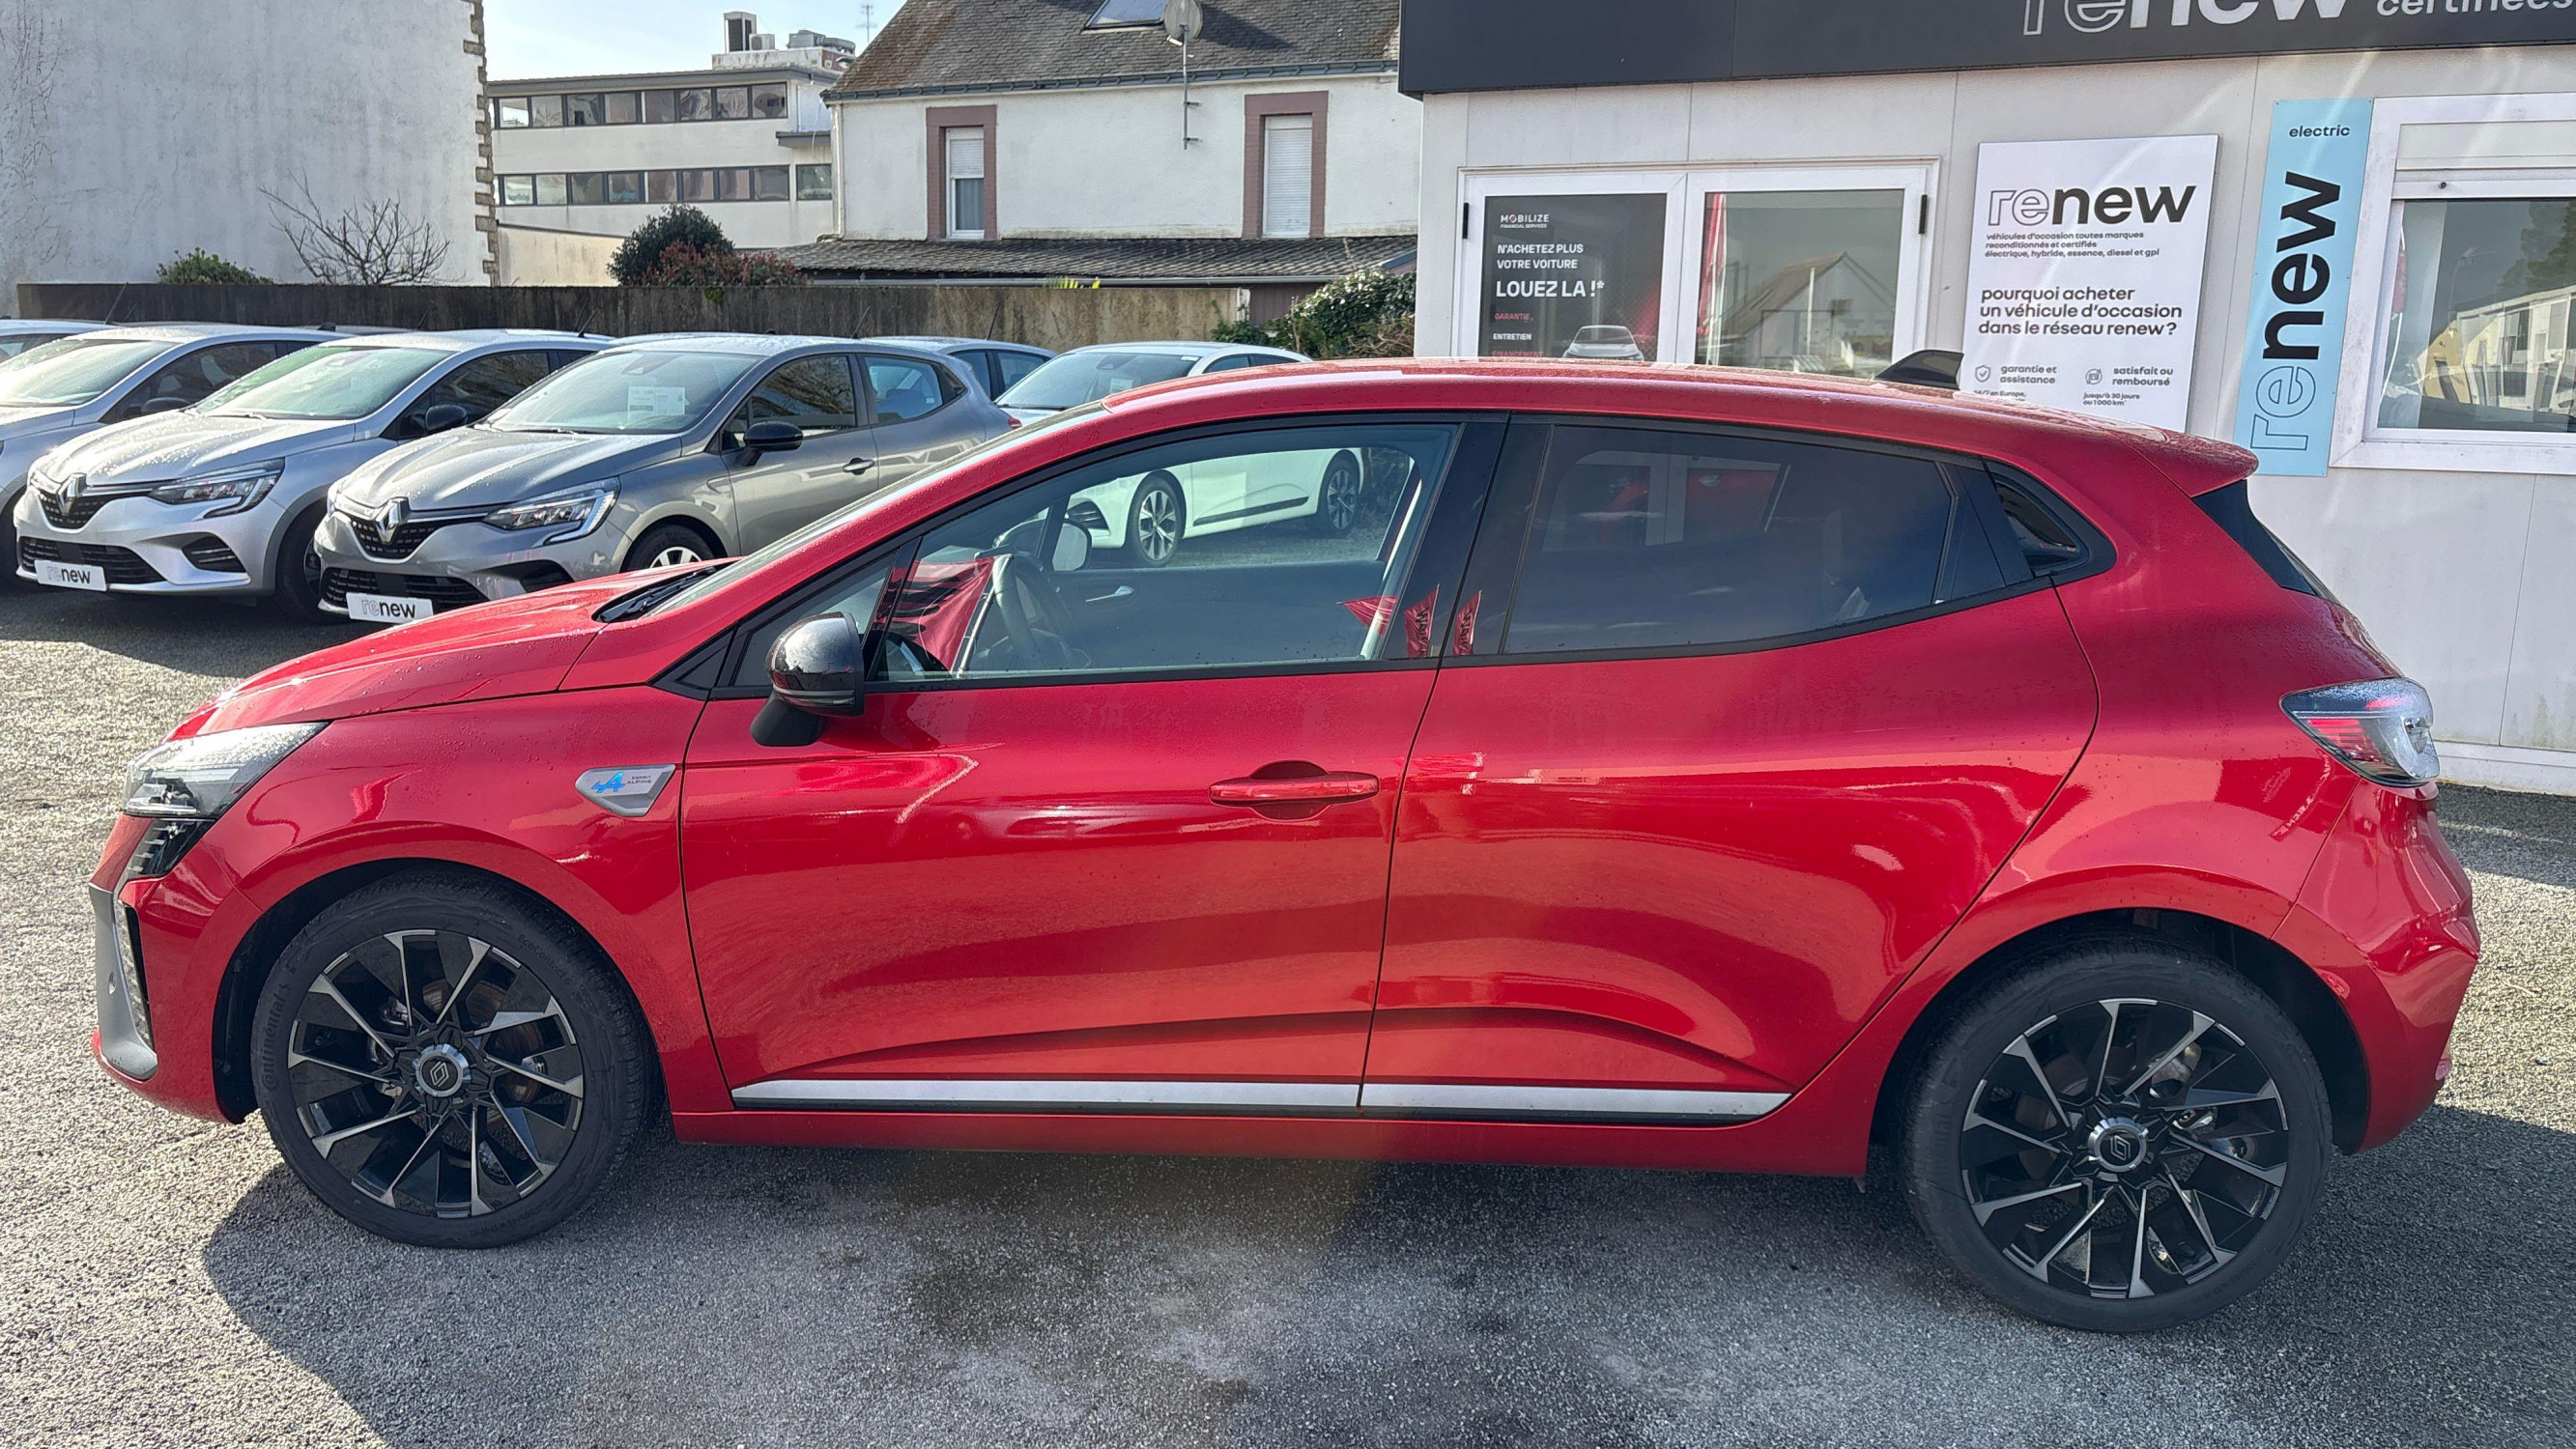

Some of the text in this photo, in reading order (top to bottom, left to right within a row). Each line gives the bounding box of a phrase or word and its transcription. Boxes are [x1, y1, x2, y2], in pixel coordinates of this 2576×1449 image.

[2289, 125, 2351, 137] electric
[1988, 185, 2196, 226] renew
[1501, 213, 1550, 223] MOBILIZE
[2027, 232, 2075, 241] d'occasion
[2104, 232, 2144, 241] marques
[1497, 243, 1584, 254] N'ACHETEZ PLUS
[1985, 249, 2030, 258] électrique,
[2030, 249, 2066, 258] hybride,
[2106, 248, 2132, 257] diesel
[2145, 248, 2160, 258] gpl
[1497, 259, 1578, 270] VOTRE VOITURE
[1496, 280, 1558, 298] LOUEZ
[1561, 280, 1587, 298] LA
[1981, 286, 2135, 303] pourquoi acheter
[1980, 303, 2183, 318] un véhicule d'occasion
[2250, 171, 2341, 450] renew
[1978, 321, 2021, 335] dans
[2024, 321, 2040, 335] le
[2043, 321, 2104, 335] réseau
[1493, 332, 1532, 341] ENTRETIEN
[2000, 364, 2057, 375] garantie et
[2113, 366, 2159, 376] satisfait
[2000, 374, 2056, 384] assistance
[2112, 377, 2170, 386] remboursé
[46, 565, 91, 584] renew
[361, 600, 415, 619] renew
